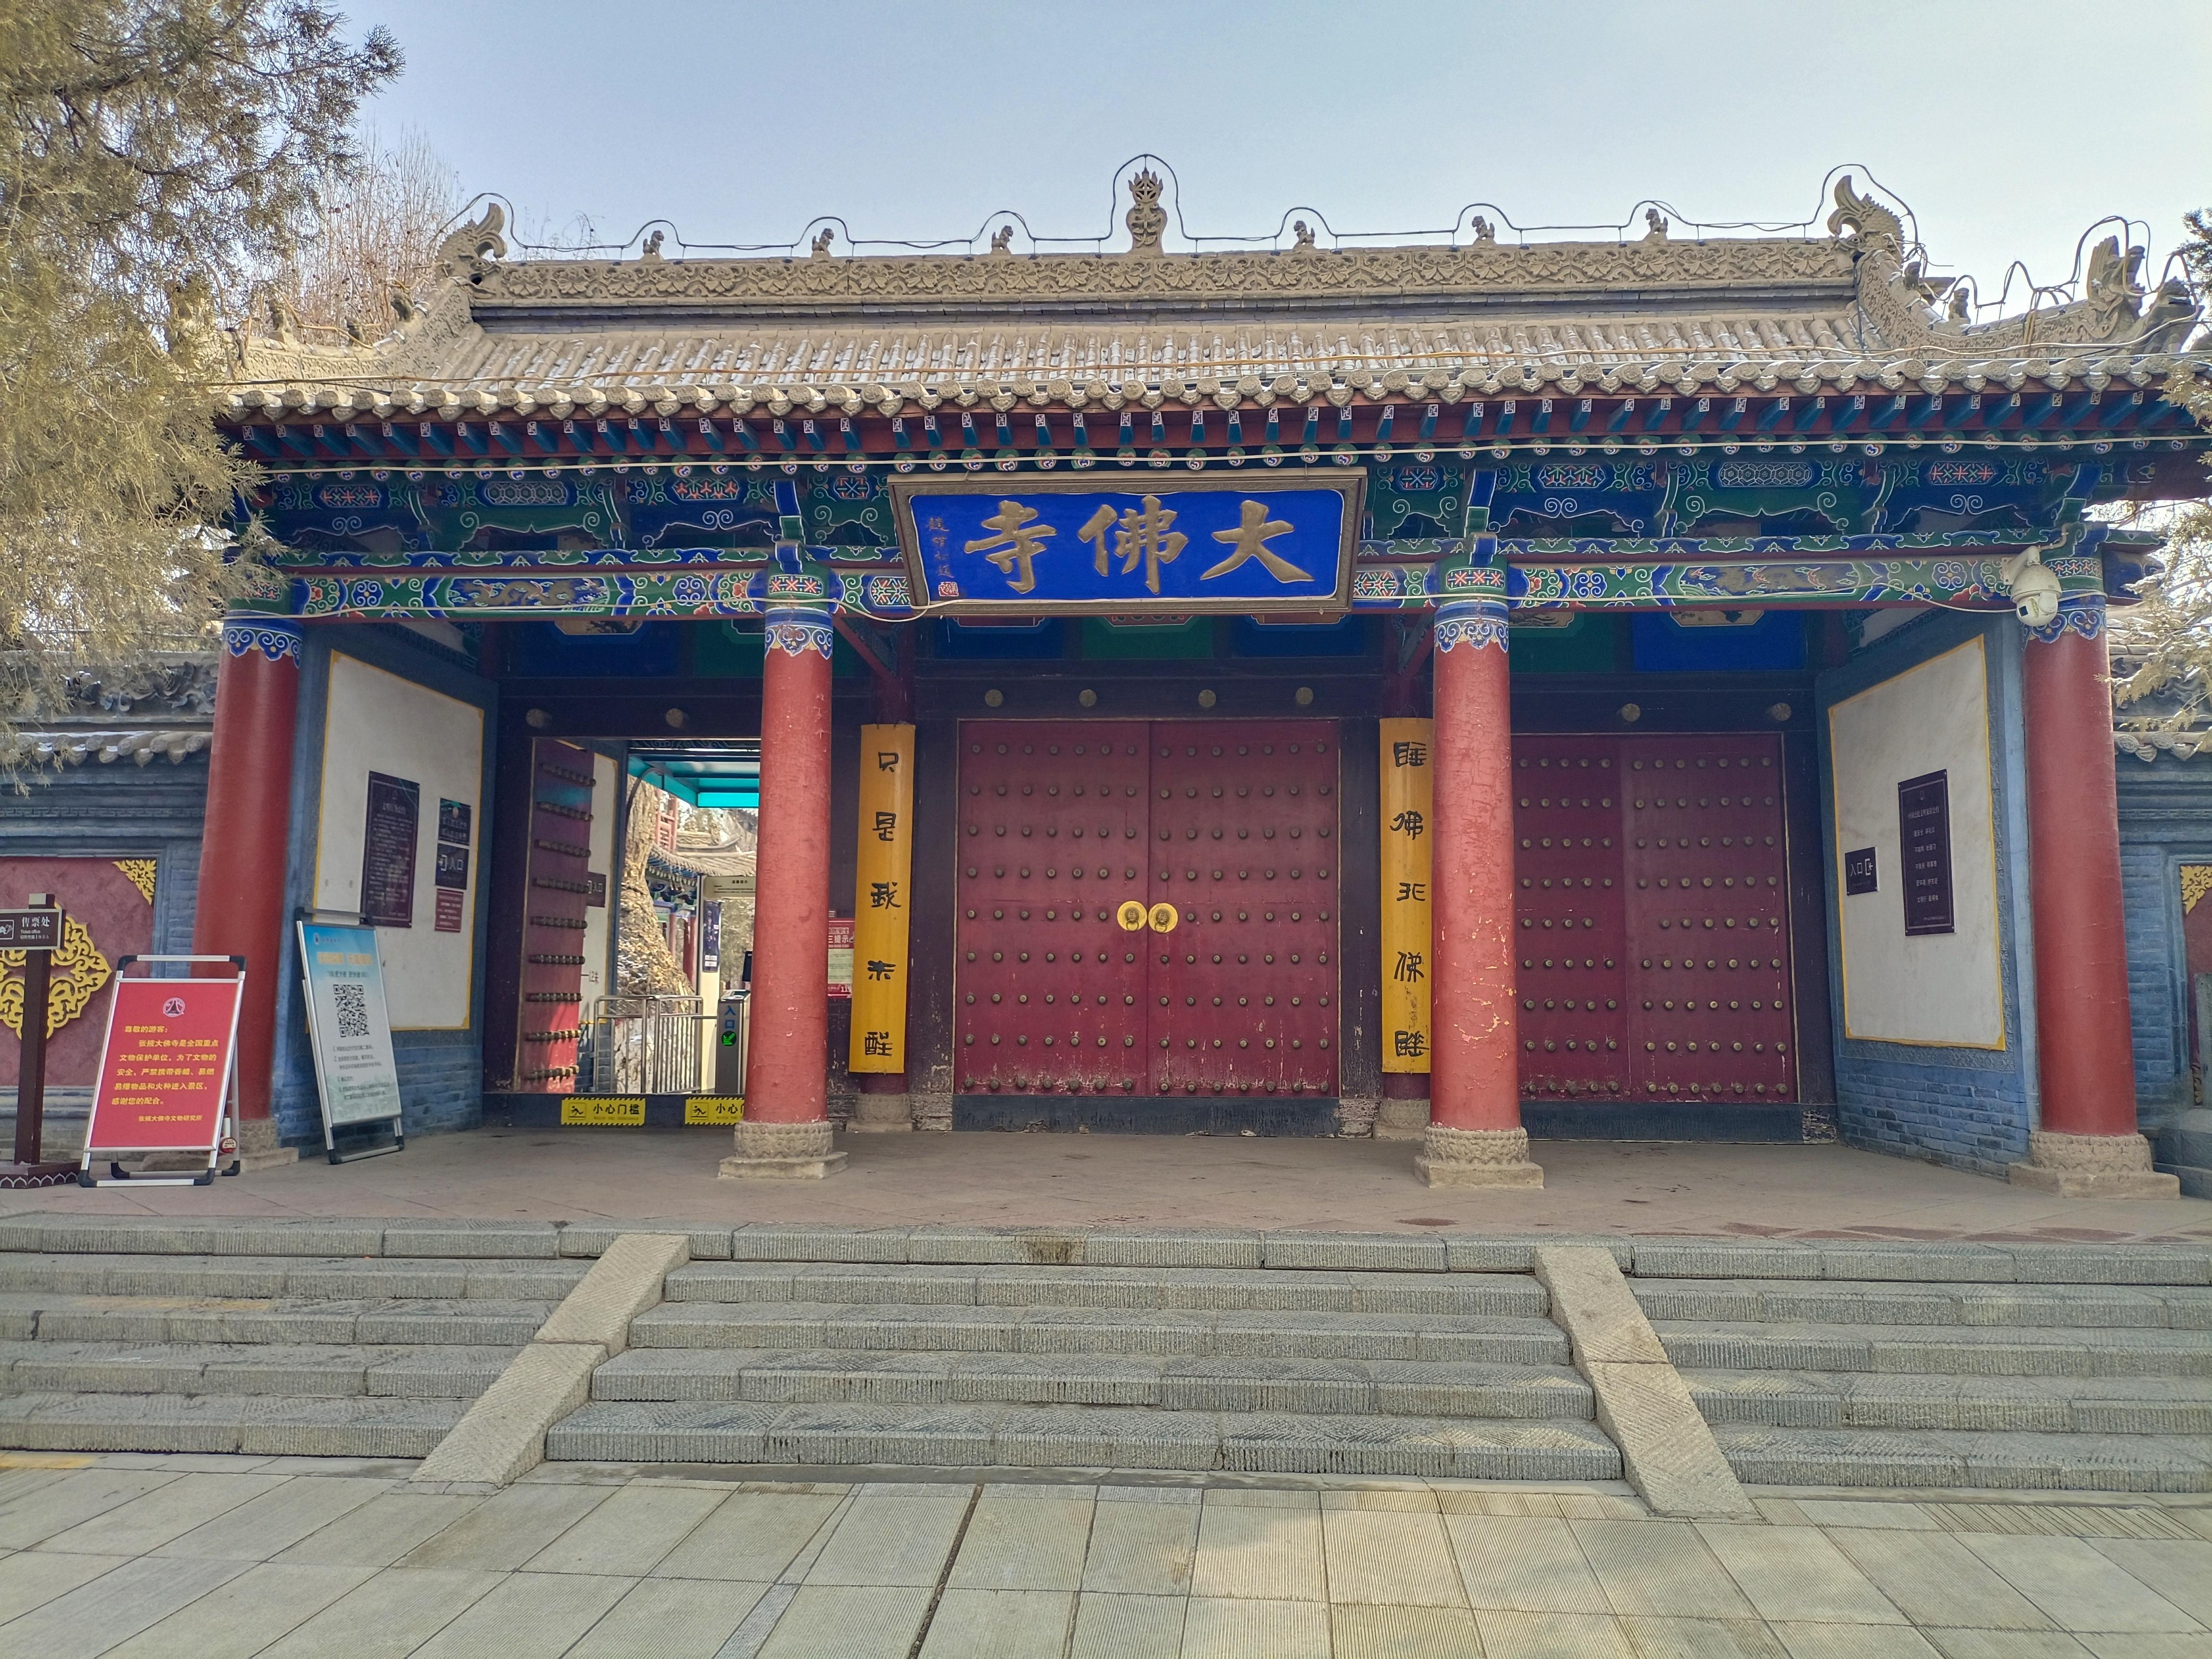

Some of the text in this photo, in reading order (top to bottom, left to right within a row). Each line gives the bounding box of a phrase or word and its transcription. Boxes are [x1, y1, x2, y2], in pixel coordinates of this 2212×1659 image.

[1850, 863, 1863, 877] 入口
[22, 916, 50, 927] 售票处
[725, 1006, 736, 1029] 入口
[593, 1103, 640, 1115] 小心门槛
